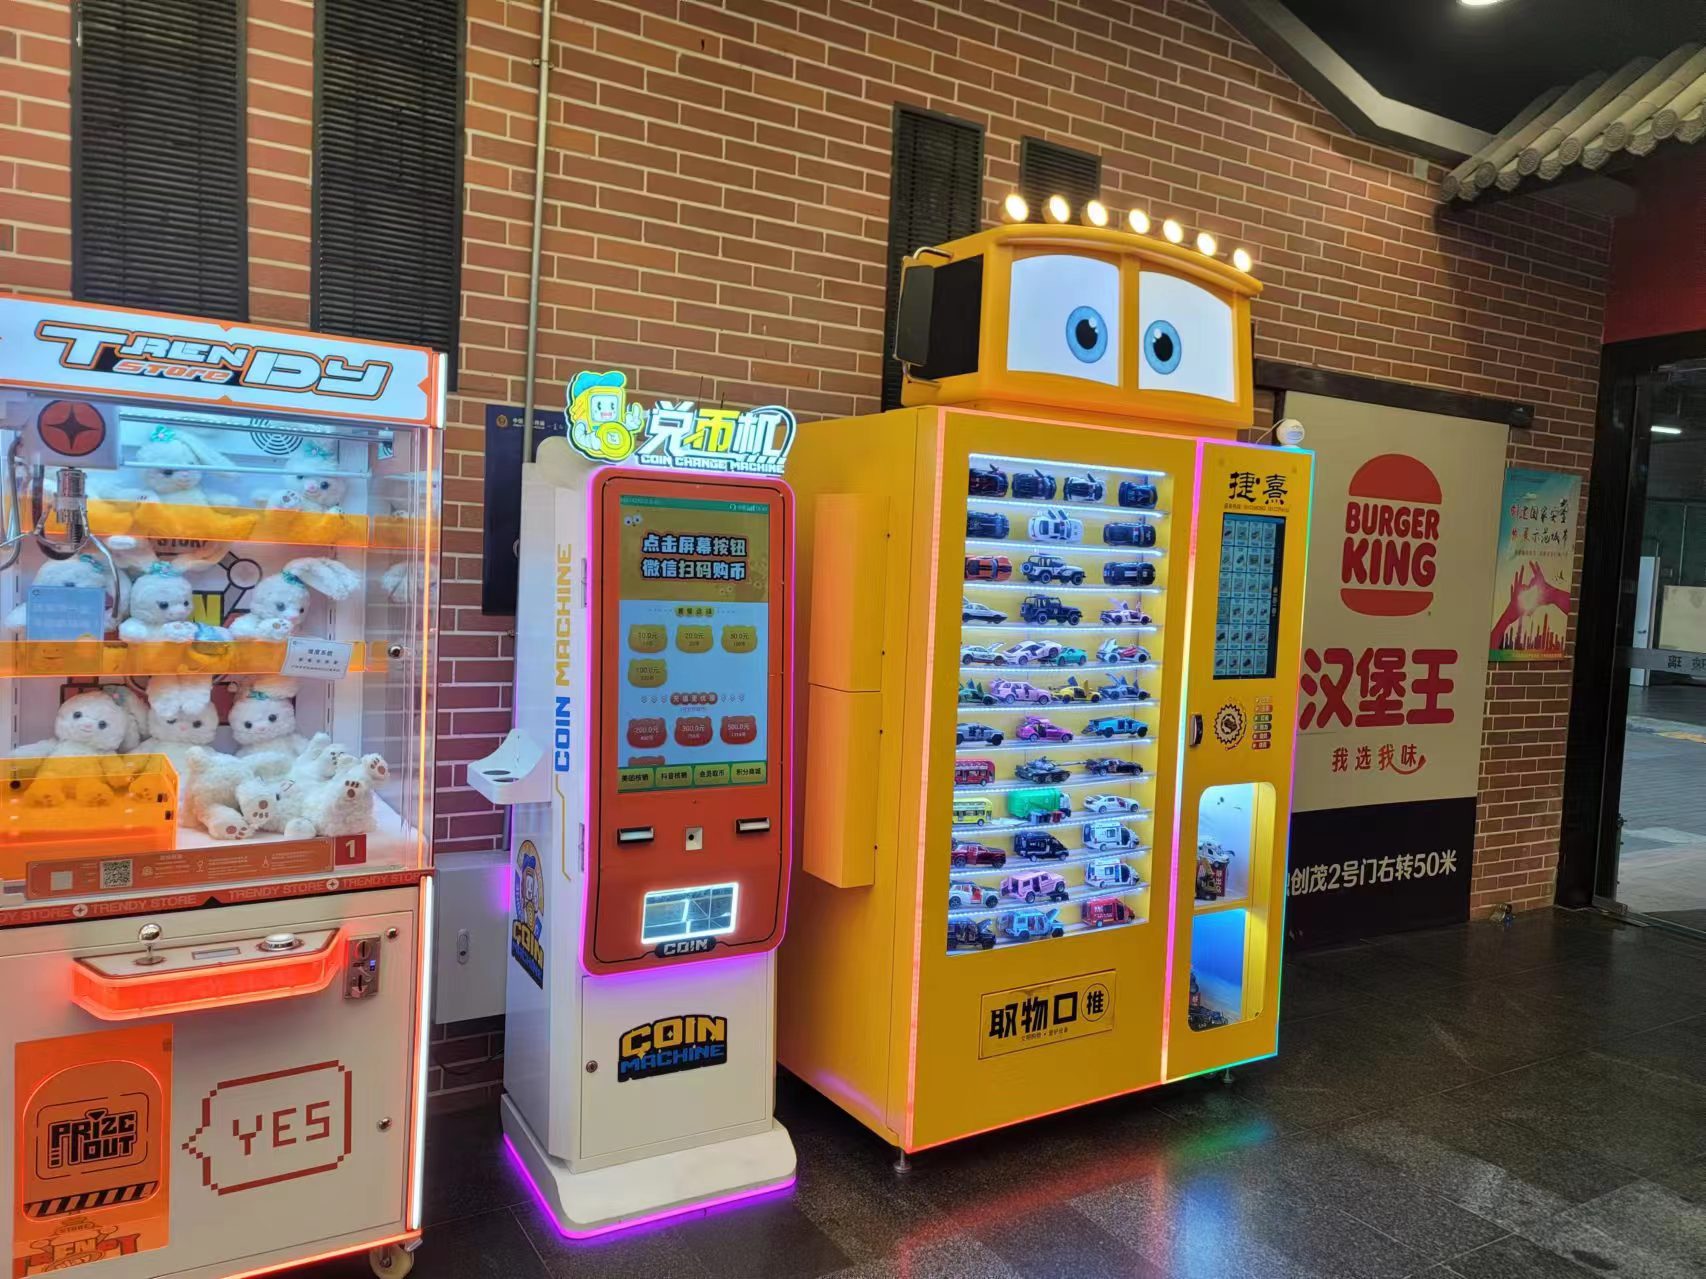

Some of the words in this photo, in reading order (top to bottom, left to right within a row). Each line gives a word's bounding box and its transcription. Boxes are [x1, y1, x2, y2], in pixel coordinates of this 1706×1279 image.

[637, 400, 794, 460] 兑币机
[640, 454, 672, 467] COIN
[675, 457, 728, 470] CHANGE
[730, 461, 785, 474] MACHINE
[1346, 501, 1440, 541] BURGER
[642, 534, 747, 557] 点击屏幕按钮
[1341, 536, 1437, 588] KING
[641, 558, 746, 580] 微信扫码购币
[555, 543, 572, 687] MACHINE
[1299, 647, 1458, 731] 汉堡王
[554, 696, 571, 772] COIN
[1332, 744, 1420, 773] 我选我味
[345, 839, 355, 858] 1
[228, 882, 281, 901] TRENDY
[283, 879, 326, 895] STORE
[343, 874, 390, 889] TRENDY
[1286, 849, 1457, 897] 创茂2号门右转50米
[21, 907, 71, 921] STORE
[91, 900, 147, 915] TRENDY
[150, 894, 197, 910] STORE
[513, 920, 544, 970] COIN
[663, 938, 709, 956] COIN
[989, 991, 1078, 1039] 取物口
[1086, 990, 1104, 1016] 推
[621, 1016, 725, 1057] COIN
[620, 1044, 725, 1075] MACHINE
[50, 1110, 136, 1167] PRIZE
[233, 1100, 331, 1156] YES
[82, 1134, 135, 1161] OUT
